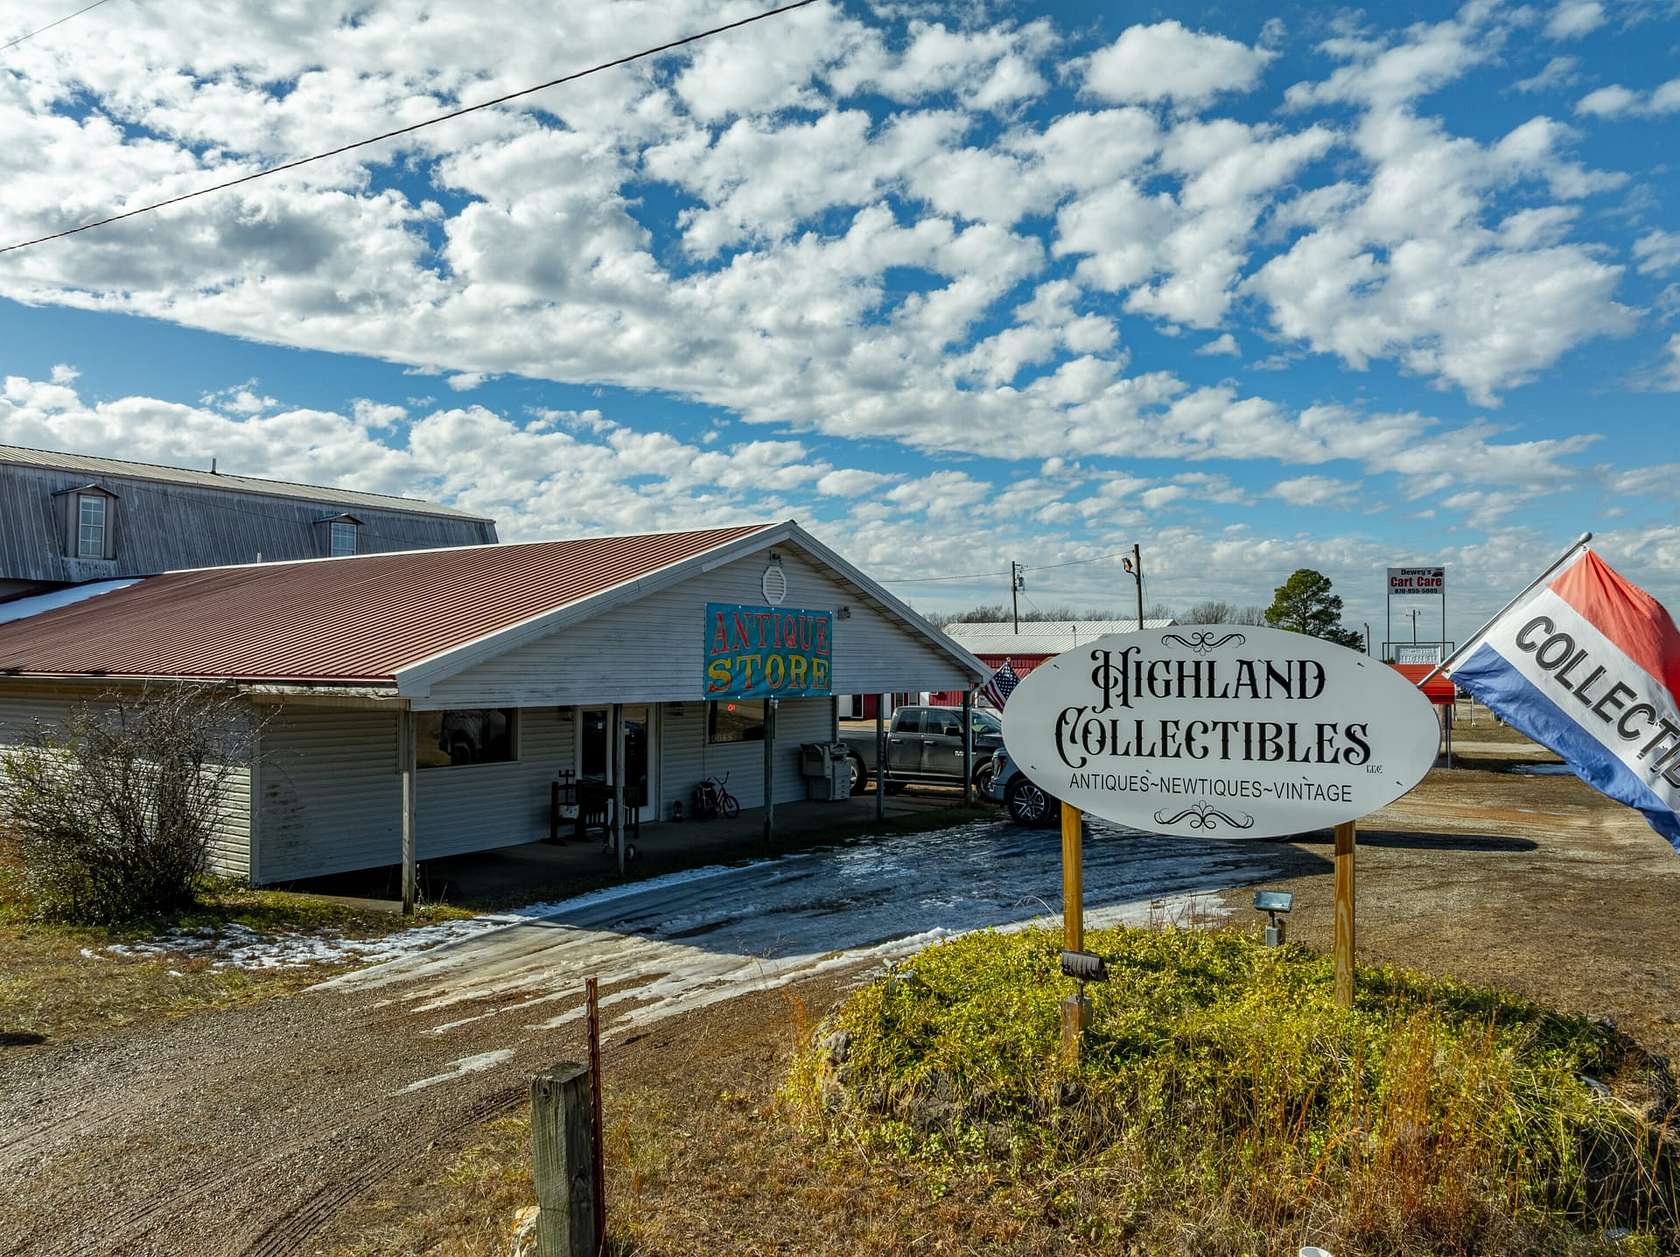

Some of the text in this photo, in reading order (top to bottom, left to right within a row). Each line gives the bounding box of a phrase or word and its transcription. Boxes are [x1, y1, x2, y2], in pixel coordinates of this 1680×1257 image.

[1391, 576, 1442, 587] Cart Care
[710, 611, 831, 656] ANTIQUE
[707, 654, 830, 693] STORE
